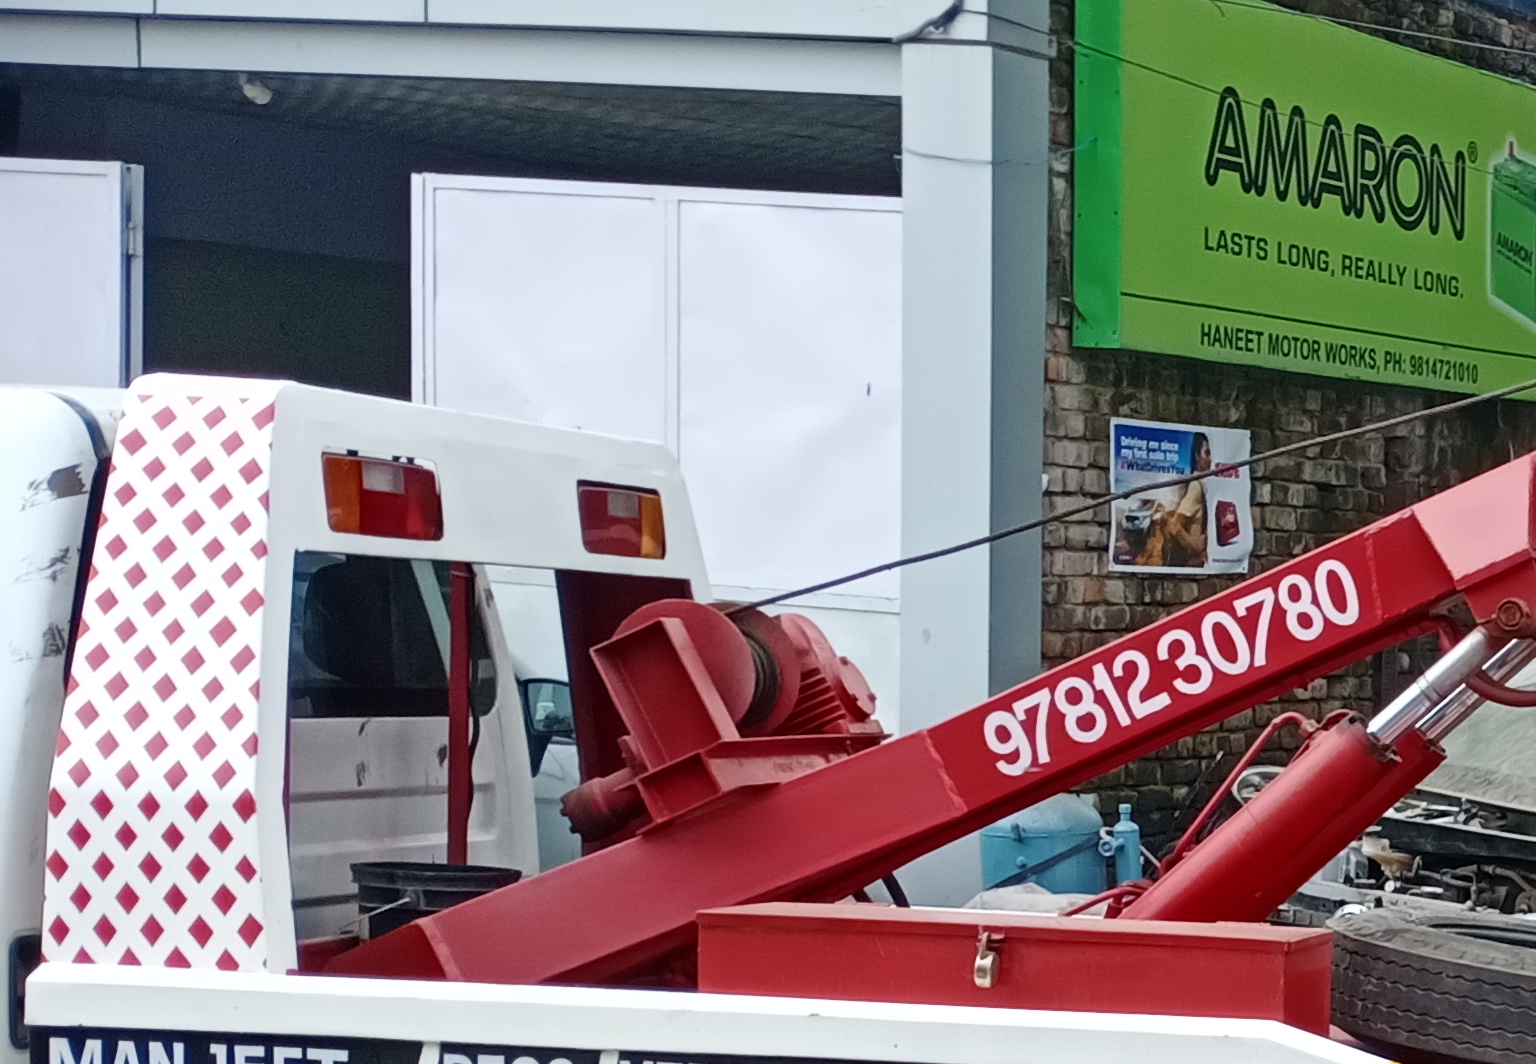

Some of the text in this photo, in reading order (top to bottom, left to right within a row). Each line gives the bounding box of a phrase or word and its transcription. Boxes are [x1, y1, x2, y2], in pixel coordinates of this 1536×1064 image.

[1204, 86, 1467, 241] AMARON
[1204, 227, 1464, 299] LASTS LONG, REALLY LONG.
[1200, 323, 1478, 385] HANEET MOTOR WORKS, PH: 9814721010
